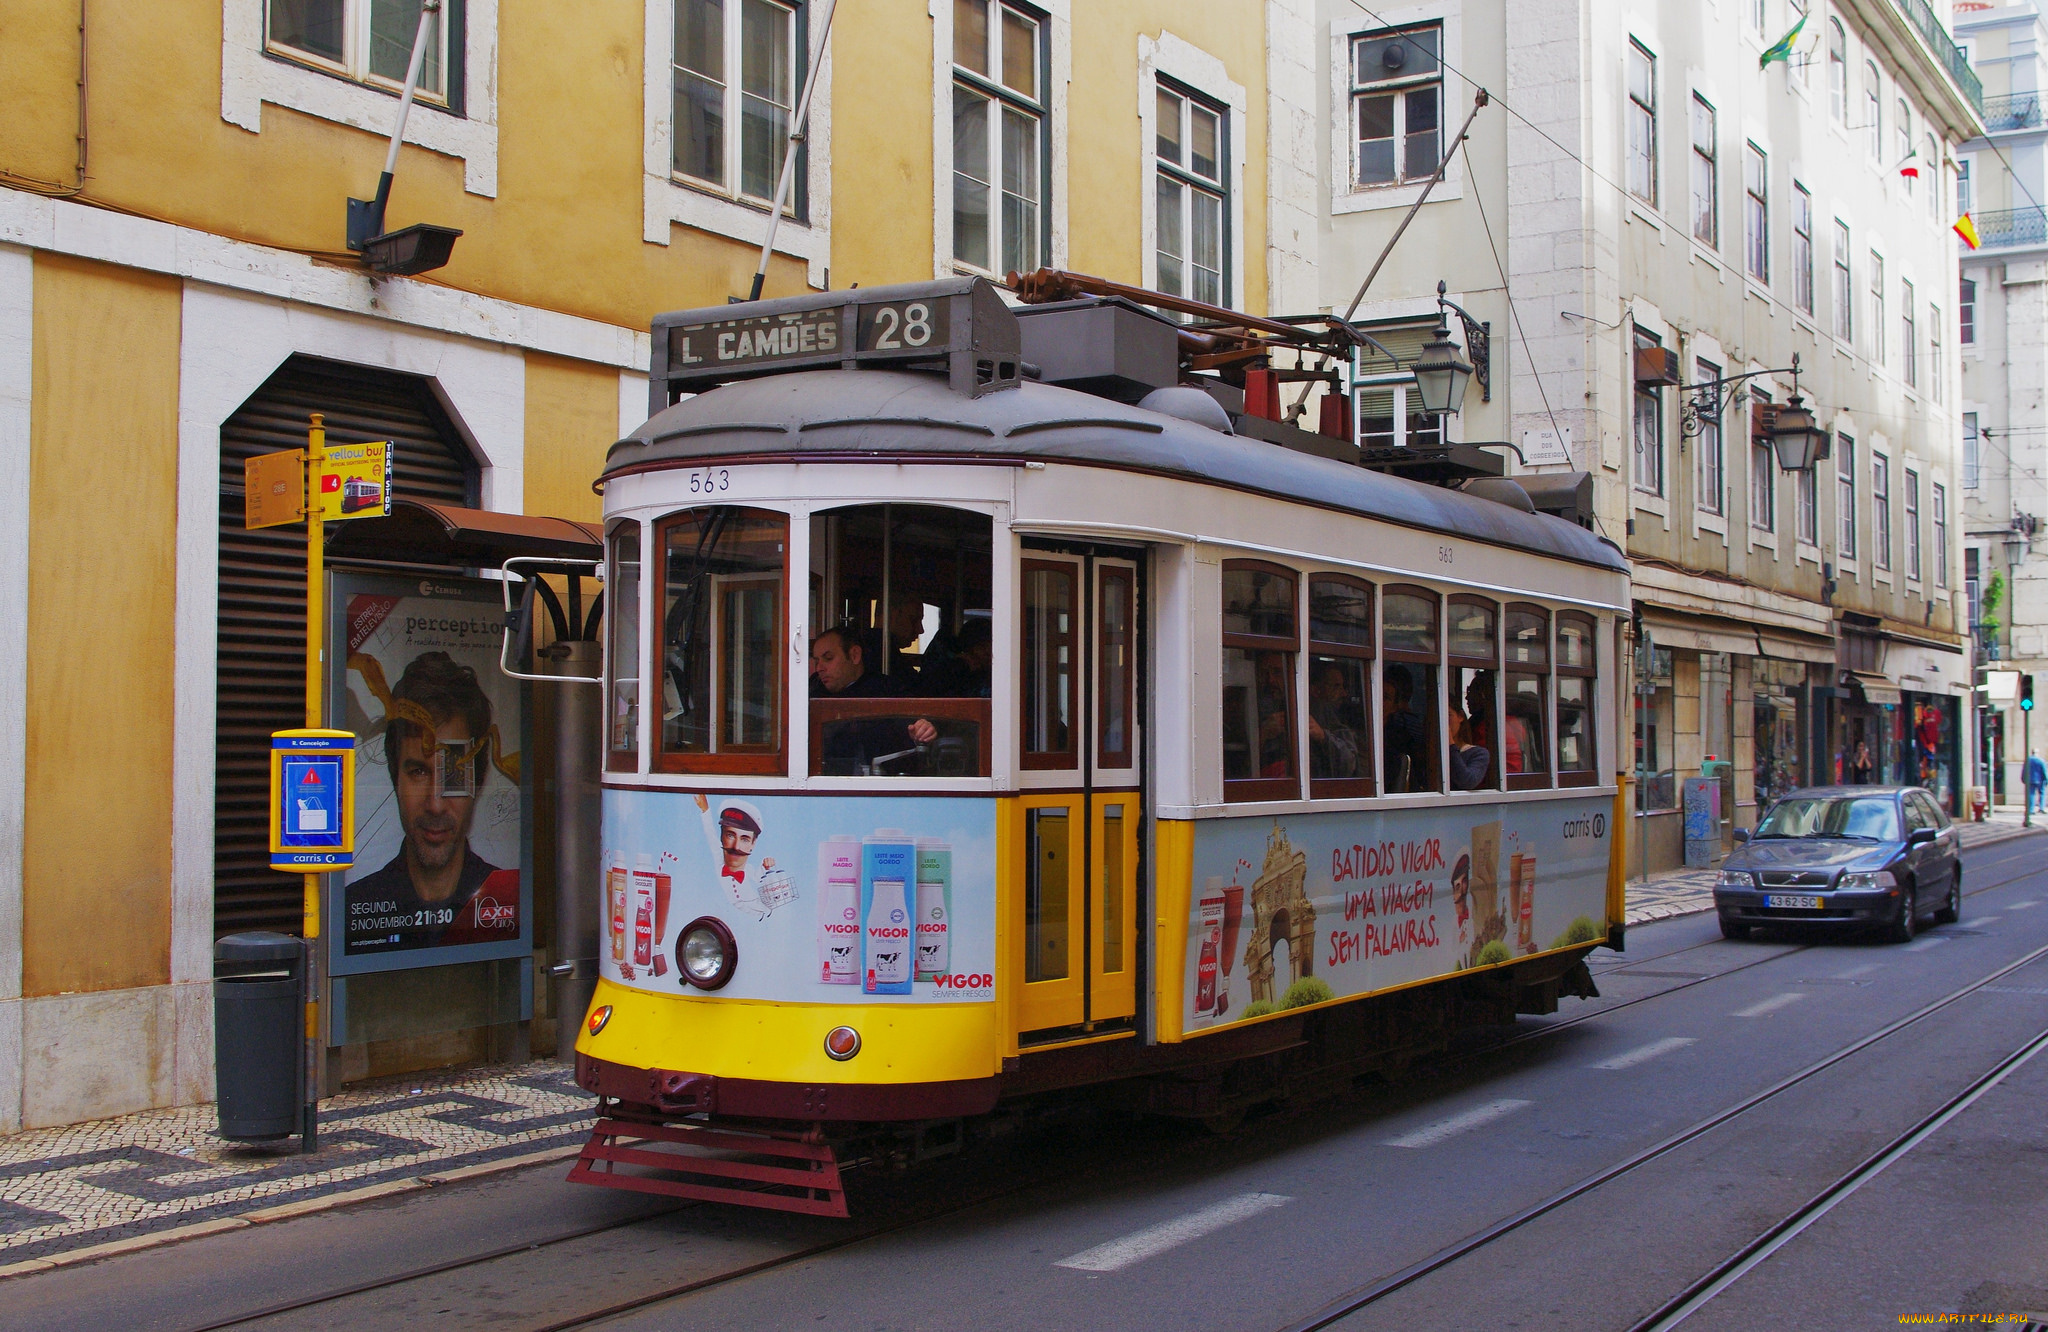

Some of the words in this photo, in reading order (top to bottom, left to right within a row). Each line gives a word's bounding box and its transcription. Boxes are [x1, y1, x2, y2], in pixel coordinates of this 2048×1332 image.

[875, 303, 932, 349] 28
[682, 336, 703, 364] L.
[717, 321, 837, 361] CAMÕES
[366, 445, 383, 457] bus
[273, 483, 287, 493] 28E
[331, 478, 337, 488] 4
[690, 469, 730, 493] 563
[1438, 546, 1454, 564] 563
[353, 601, 379, 630] ESTREIA
[350, 632, 363, 649] EM
[1563, 812, 1590, 839] carris
[294, 854, 321, 863] carris
[1332, 841, 1396, 882] BATIDOS
[1401, 838, 1446, 873] VIGOR,
[351, 901, 397, 915] SEGUNDA
[1344, 888, 1376, 921] UMA
[1381, 880, 1433, 916] VIAGEM
[1770, 896, 1782, 907] 43
[1784, 897, 1798, 907] 62
[1801, 897, 1817, 908] SC
[358, 914, 413, 930] NOVEMBRO
[414, 908, 453, 926] 21h30
[482, 907, 513, 920] AXN
[635, 925, 652, 934] VIGOR
[824, 924, 860, 934] VIGOR
[868, 928, 909, 938] VIGOR
[1328, 931, 1360, 967] SEM
[1364, 914, 1440, 960] PALAVRAS.
[1199, 962, 1217, 973] VIGOR
[932, 973, 993, 989] VIGOR
[931, 990, 960, 998] SEMPRE
